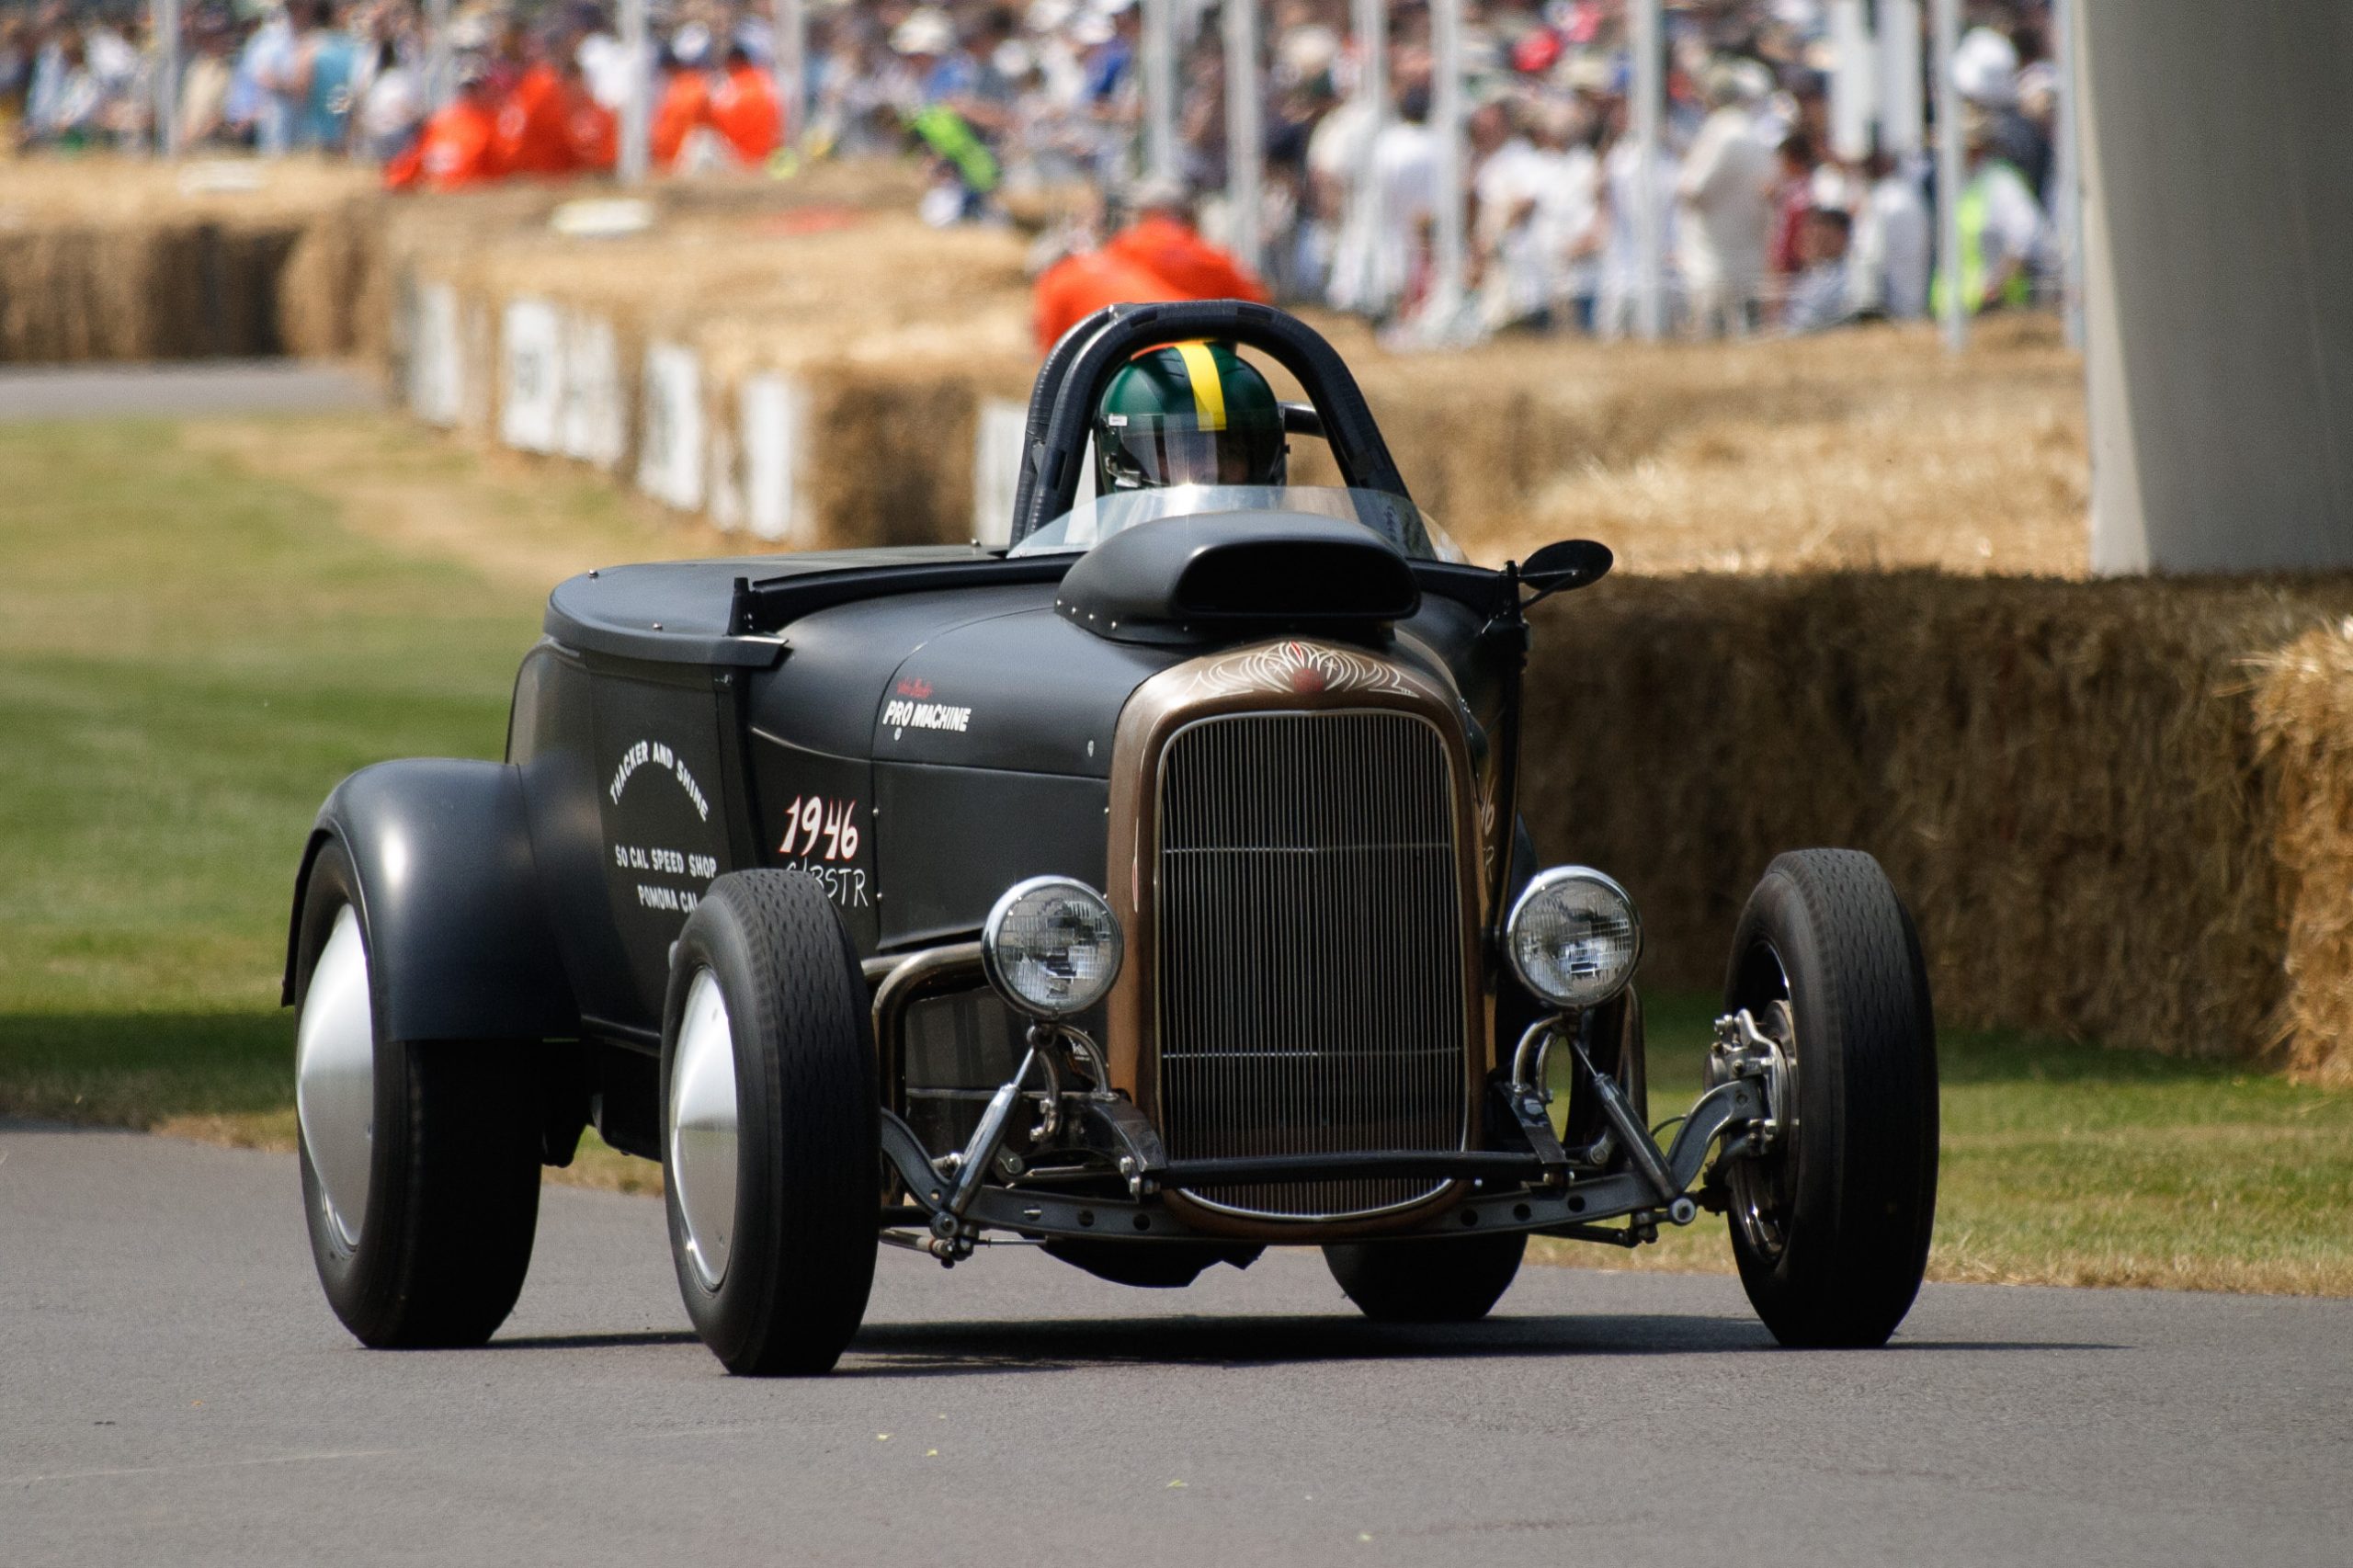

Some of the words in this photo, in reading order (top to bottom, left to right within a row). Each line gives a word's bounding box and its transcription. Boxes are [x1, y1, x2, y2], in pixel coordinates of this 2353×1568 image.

[882, 699, 914, 727] PRO
[911, 703, 972, 733] MACHINE
[609, 740, 649, 805] THACKER
[653, 741, 673, 769] AND
[676, 758, 708, 822] SHINE
[779, 794, 858, 860] 1946
[615, 844, 629, 868] SO
[630, 846, 650, 869] CAL
[651, 848, 685, 874] SPEED
[688, 853, 717, 879] SHOP
[637, 884, 679, 911] POMONA
